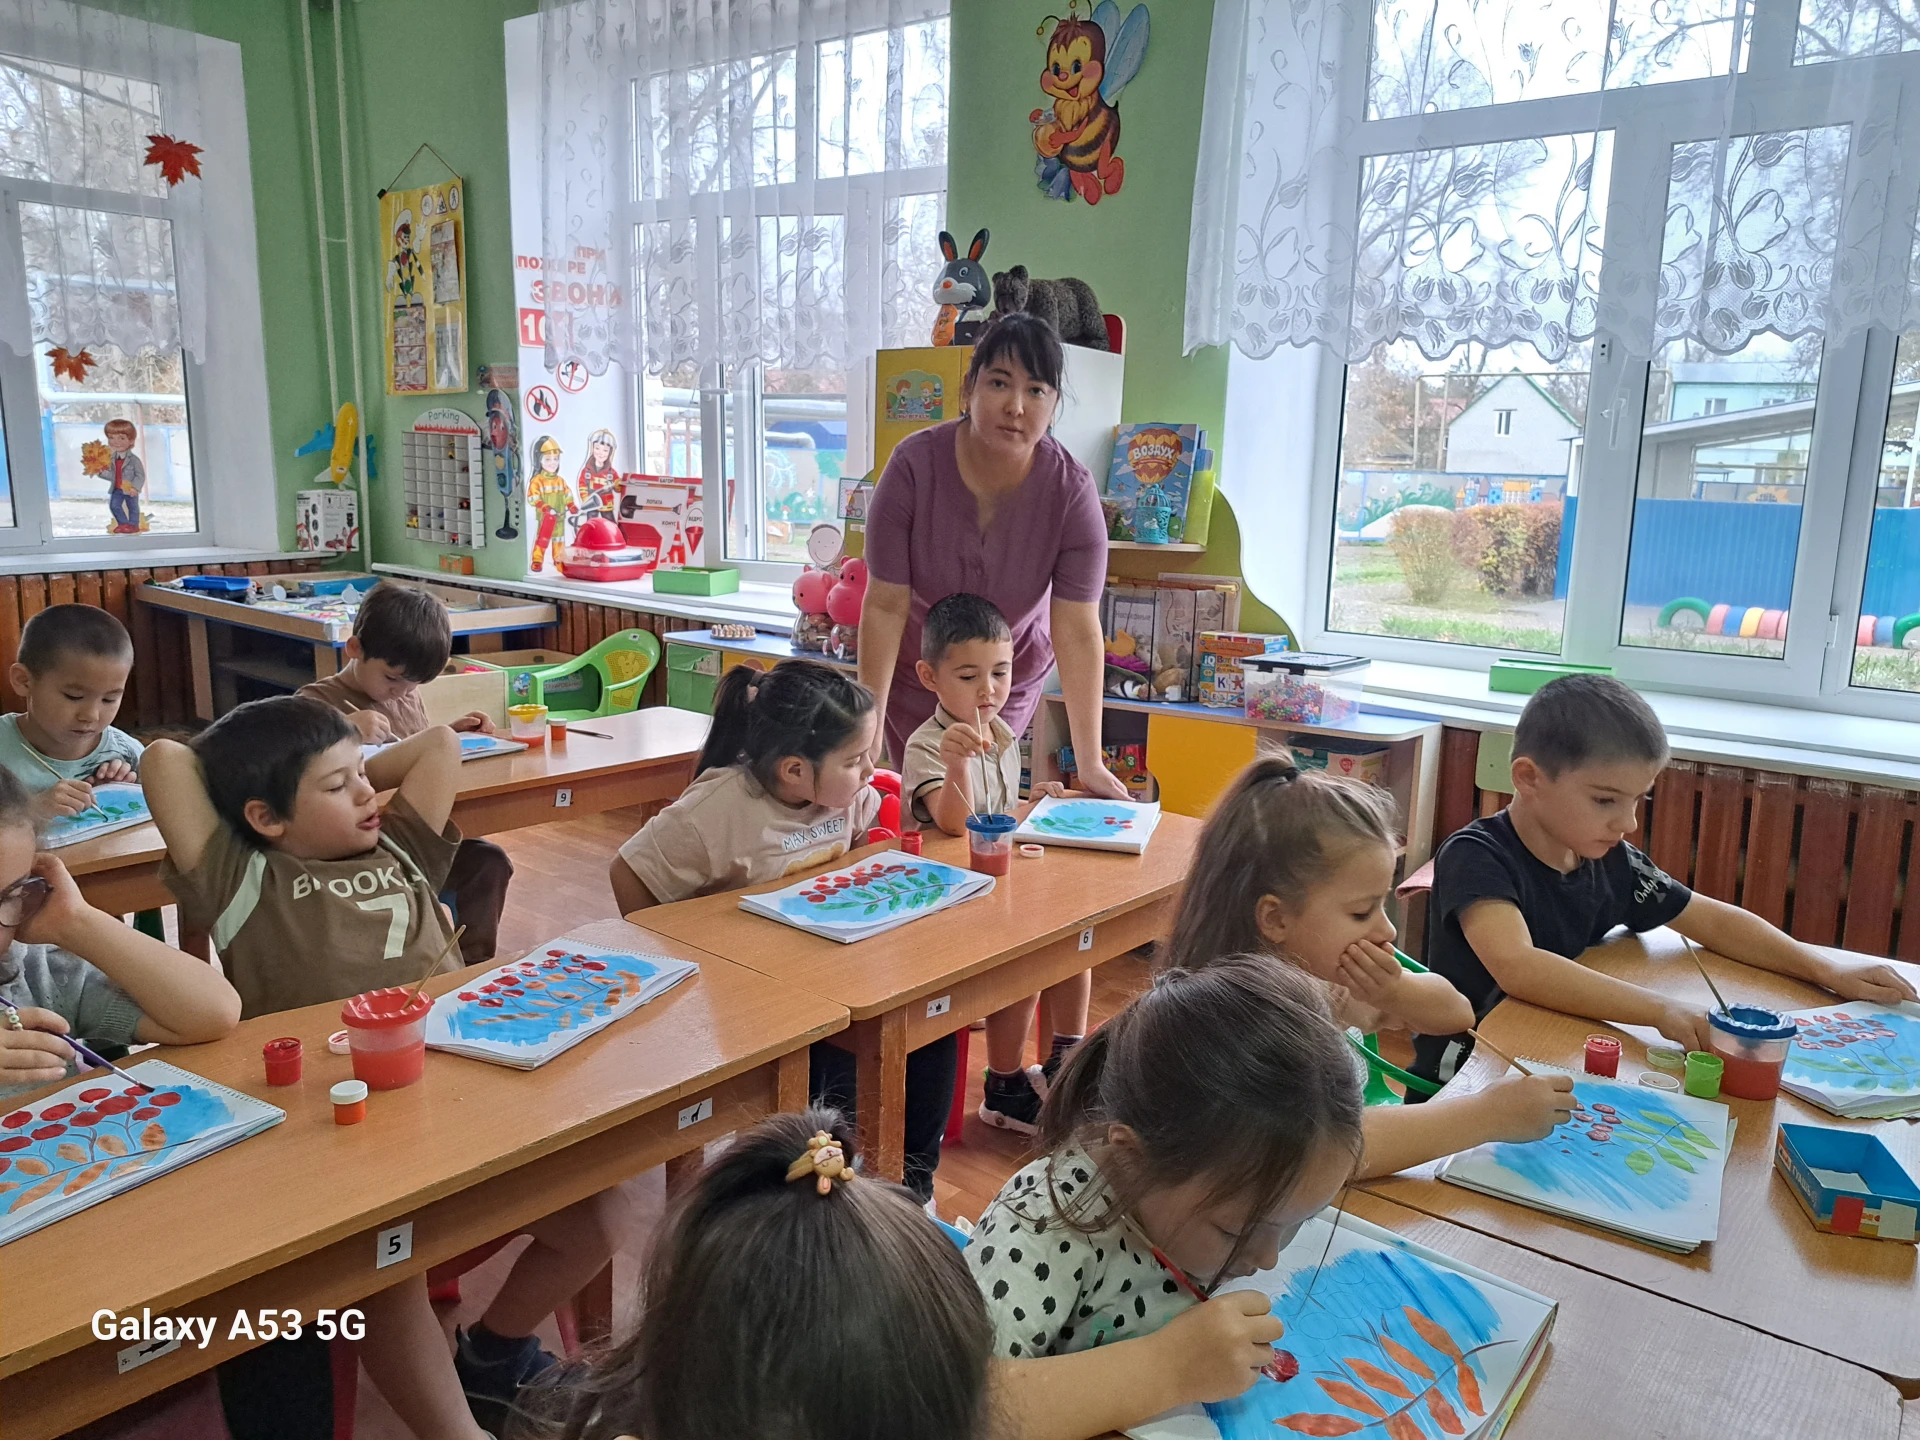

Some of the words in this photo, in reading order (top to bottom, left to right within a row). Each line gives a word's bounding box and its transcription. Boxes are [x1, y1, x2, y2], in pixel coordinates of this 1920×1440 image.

[517, 255, 586, 274] ПОРЕ
[428, 409, 460, 424] Parking
[1132, 444, 1175, 460] ВОЗДУХ
[560, 792, 567, 802] 9
[810, 818, 845, 839] SWEET
[293, 866, 413, 900] BOOK
[1633, 879, 1659, 904] Only
[356, 892, 410, 960] 7
[1083, 931, 1090, 944] 6
[388, 1234, 402, 1256] 5
